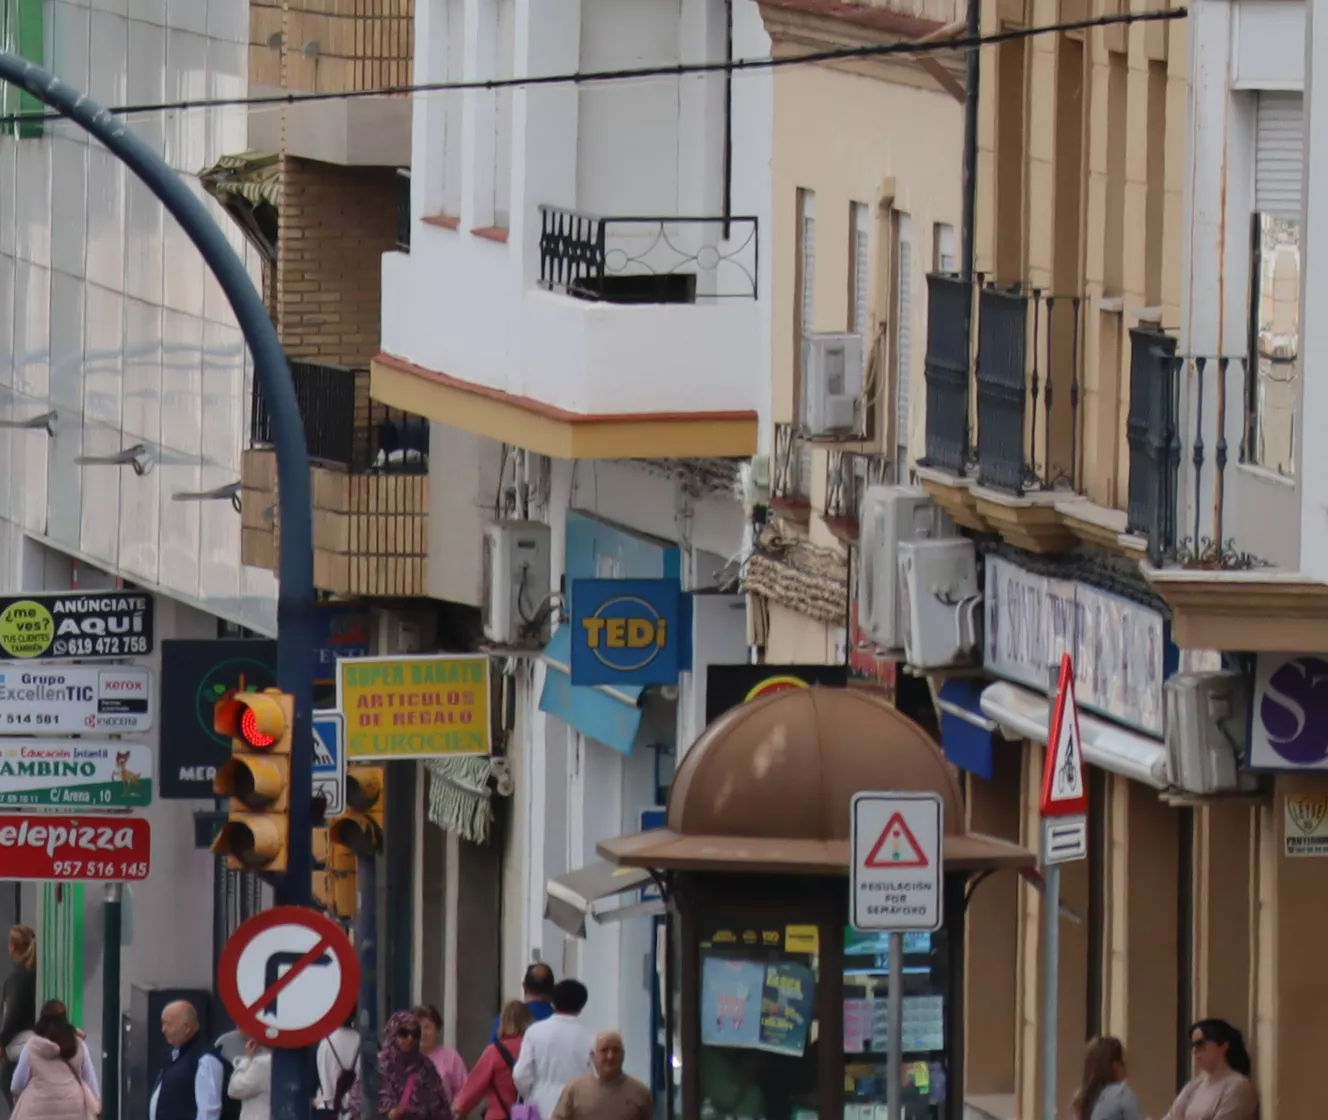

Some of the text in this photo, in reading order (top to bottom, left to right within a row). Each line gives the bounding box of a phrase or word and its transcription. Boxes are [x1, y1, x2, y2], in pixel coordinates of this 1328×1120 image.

[5, 608, 36, 621] ¿me
[17, 618, 49, 631] ves?
[56, 612, 143, 635] AQUÍ
[69, 637, 147, 654] 619 472 758
[22, 674, 65, 685] Grupo
[347, 665, 404, 688] SUPER
[105, 680, 142, 690] xerox
[357, 691, 474, 708] ARTICULOS
[7, 714, 32, 725] 514
[359, 710, 473, 727] DE REGALO
[50, 787, 60, 800] C/
[99, 790, 112, 803] 10
[54, 861, 147, 877] 957 516 145
